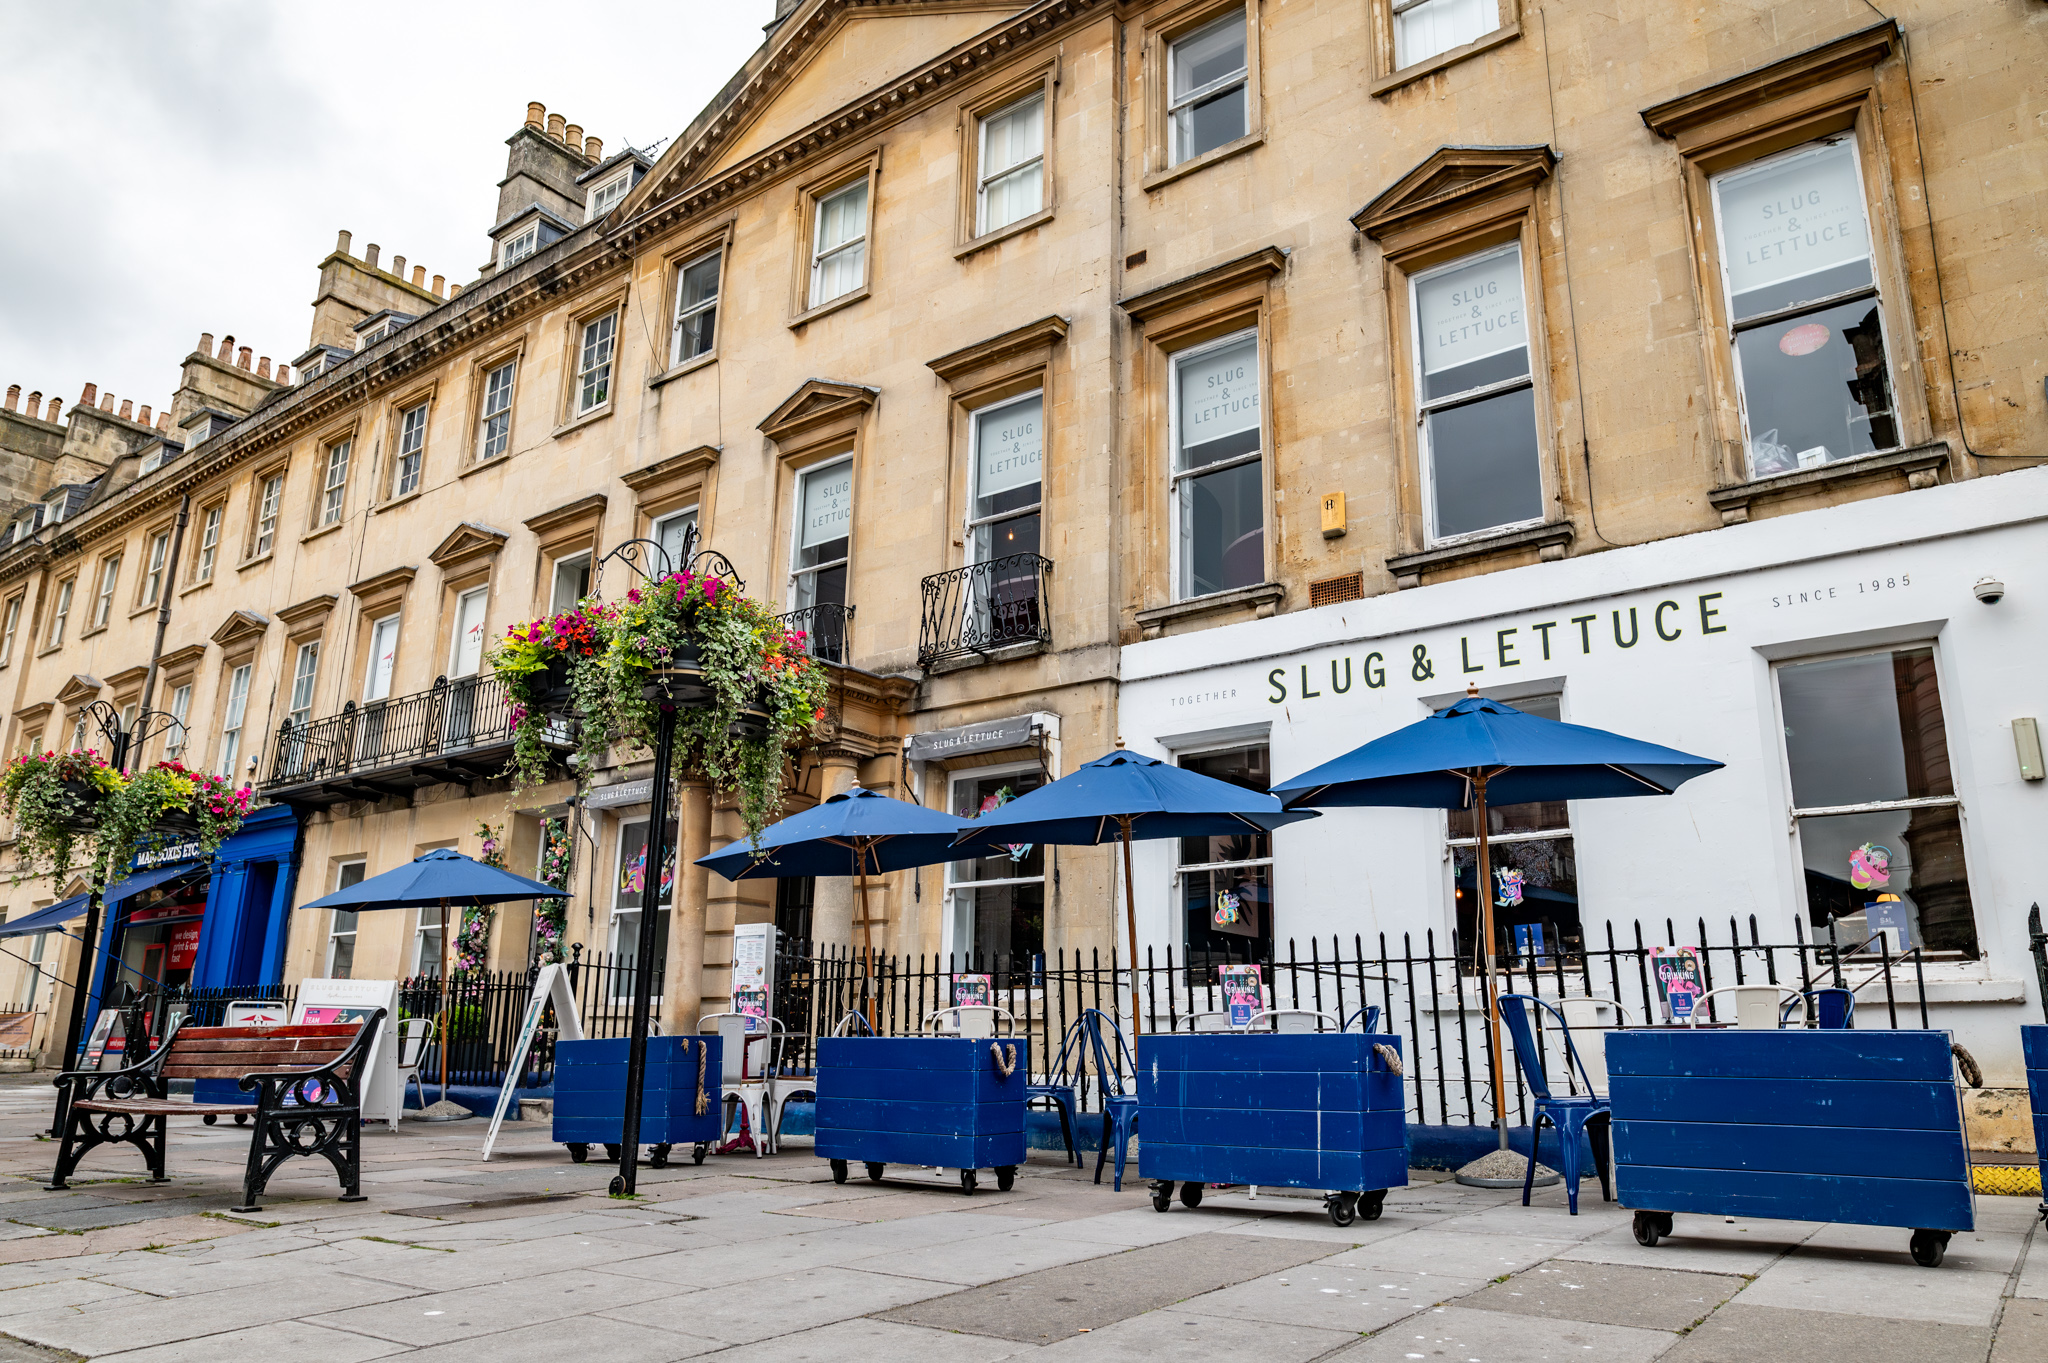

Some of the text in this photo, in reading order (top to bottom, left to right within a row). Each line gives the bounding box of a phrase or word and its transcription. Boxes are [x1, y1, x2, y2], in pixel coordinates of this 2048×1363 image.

[1762, 190, 1821, 220] SLUG
[1787, 217, 1802, 232] &
[1746, 221, 1851, 265] LETTUCE
[1452, 281, 1498, 306] SLUG
[1471, 305, 1482, 319] &
[1439, 310, 1520, 348] LETTUCE
[1207, 366, 1244, 389] SLUG
[1221, 387, 1231, 400] &
[1195, 393, 1259, 424] LETTUCE
[1002, 423, 1033, 442] SLUG
[1012, 442, 1021, 453] &
[989, 449, 1043, 475] LETTUCE
[823, 481, 849, 499] SLUG
[831, 498, 838, 509] &
[812, 507, 851, 528] LETTUC
[1171, 574, 1911, 707] TOGETHER SLUG & LETTUCE SINCE 1985
[933, 738, 954, 750] SLUG
[963, 729, 1004, 744] LETTUCE
[619, 786, 648, 797] LETTUCE
[175, 929, 199, 942] we design,
[173, 940, 199, 953] print & cop
[171, 954, 181, 963] fast
[305, 1016, 320, 1024] TEAM
